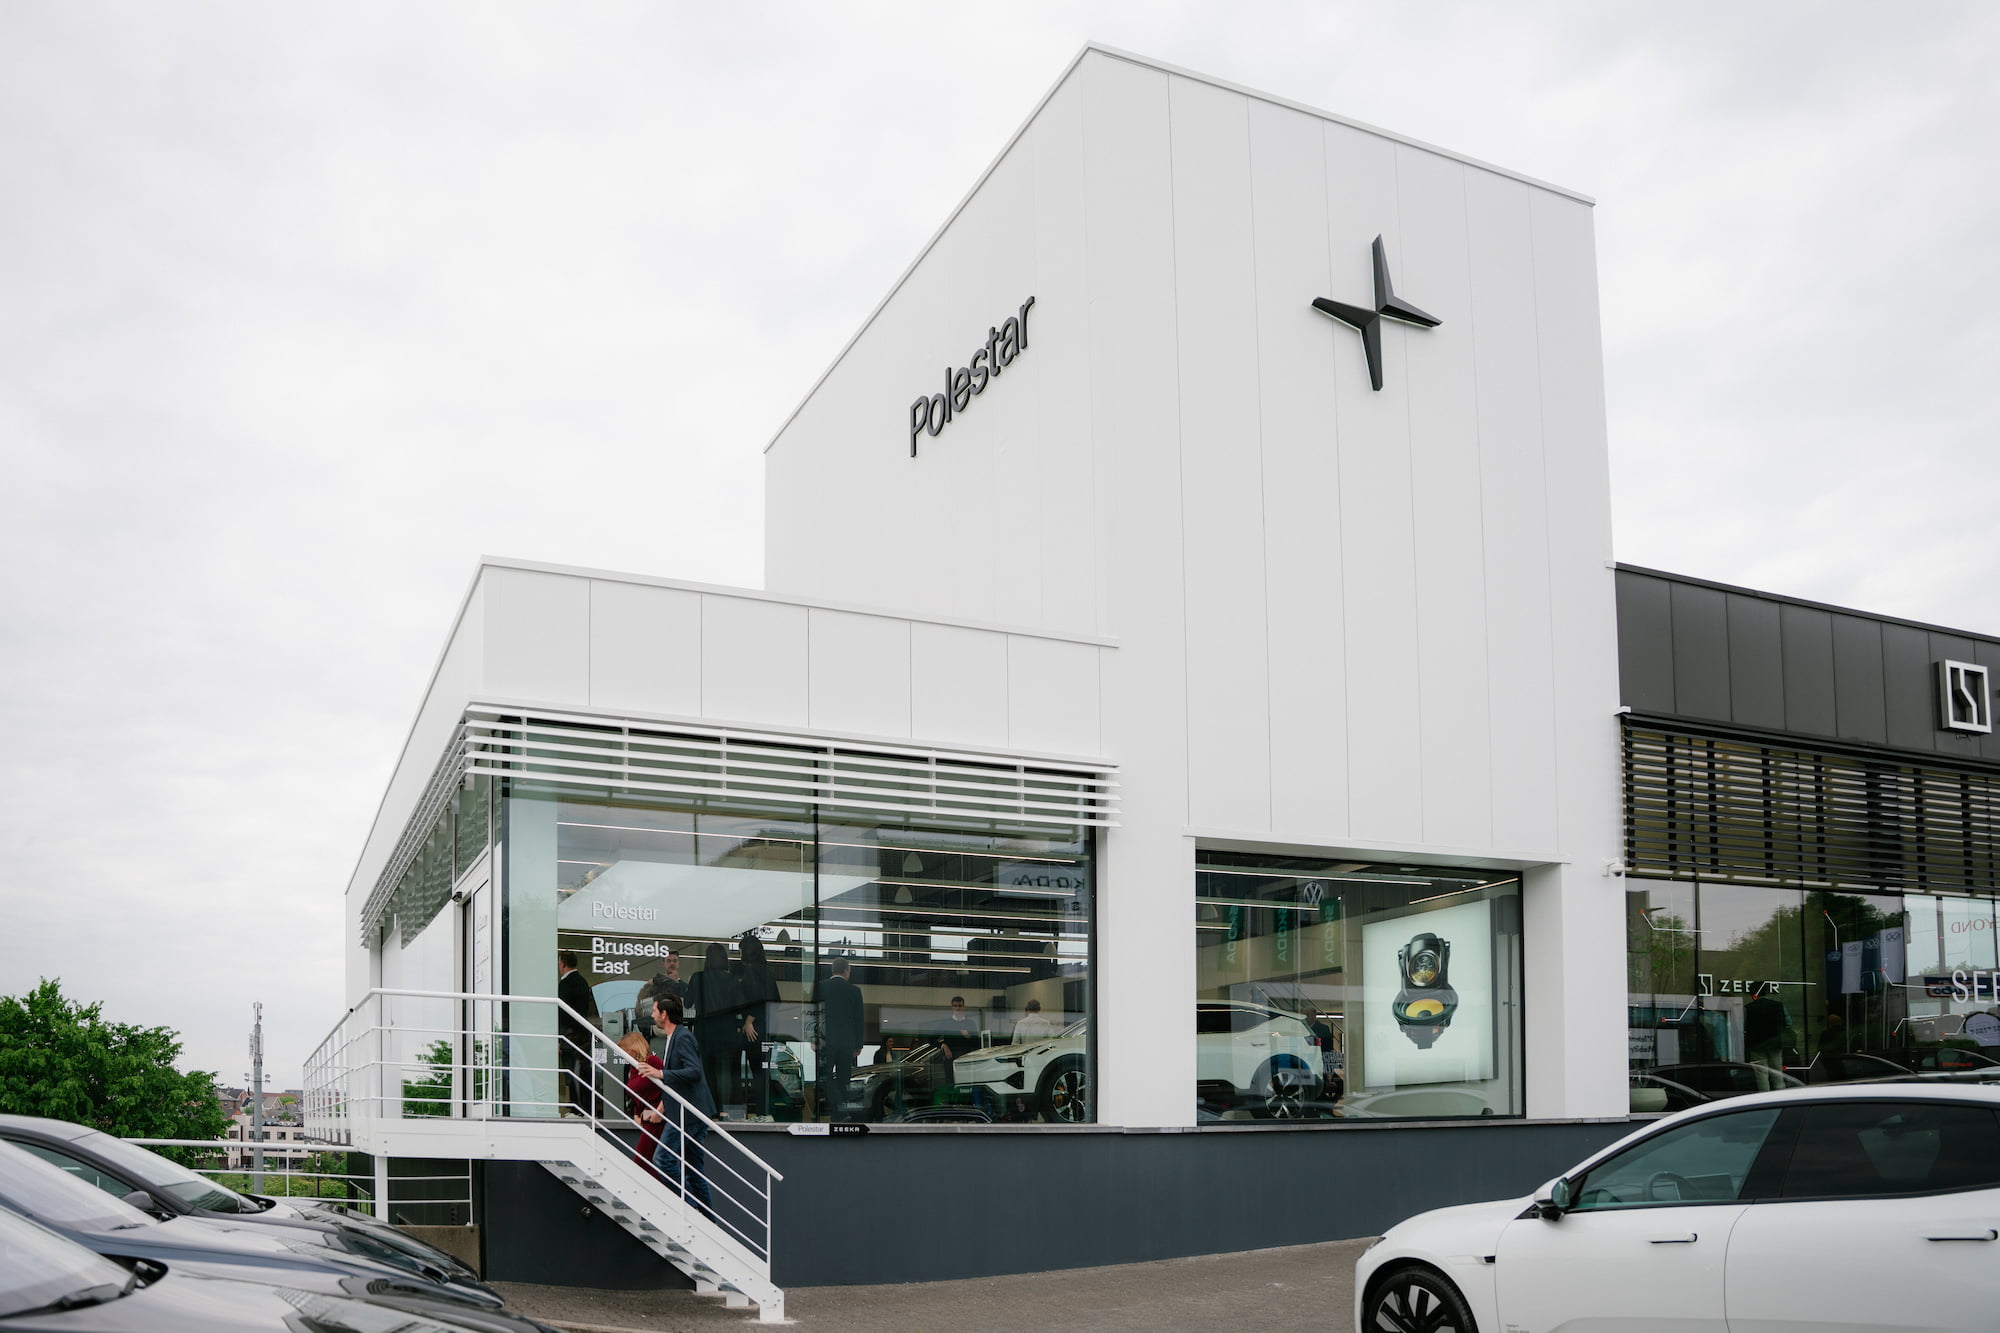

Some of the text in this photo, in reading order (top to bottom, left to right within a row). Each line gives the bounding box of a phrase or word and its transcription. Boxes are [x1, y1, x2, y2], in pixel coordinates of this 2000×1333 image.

[910, 296, 1035, 457] Polestar
[592, 900, 661, 920] Polestar
[592, 937, 670, 958] Brussels
[592, 956, 631, 975] East
